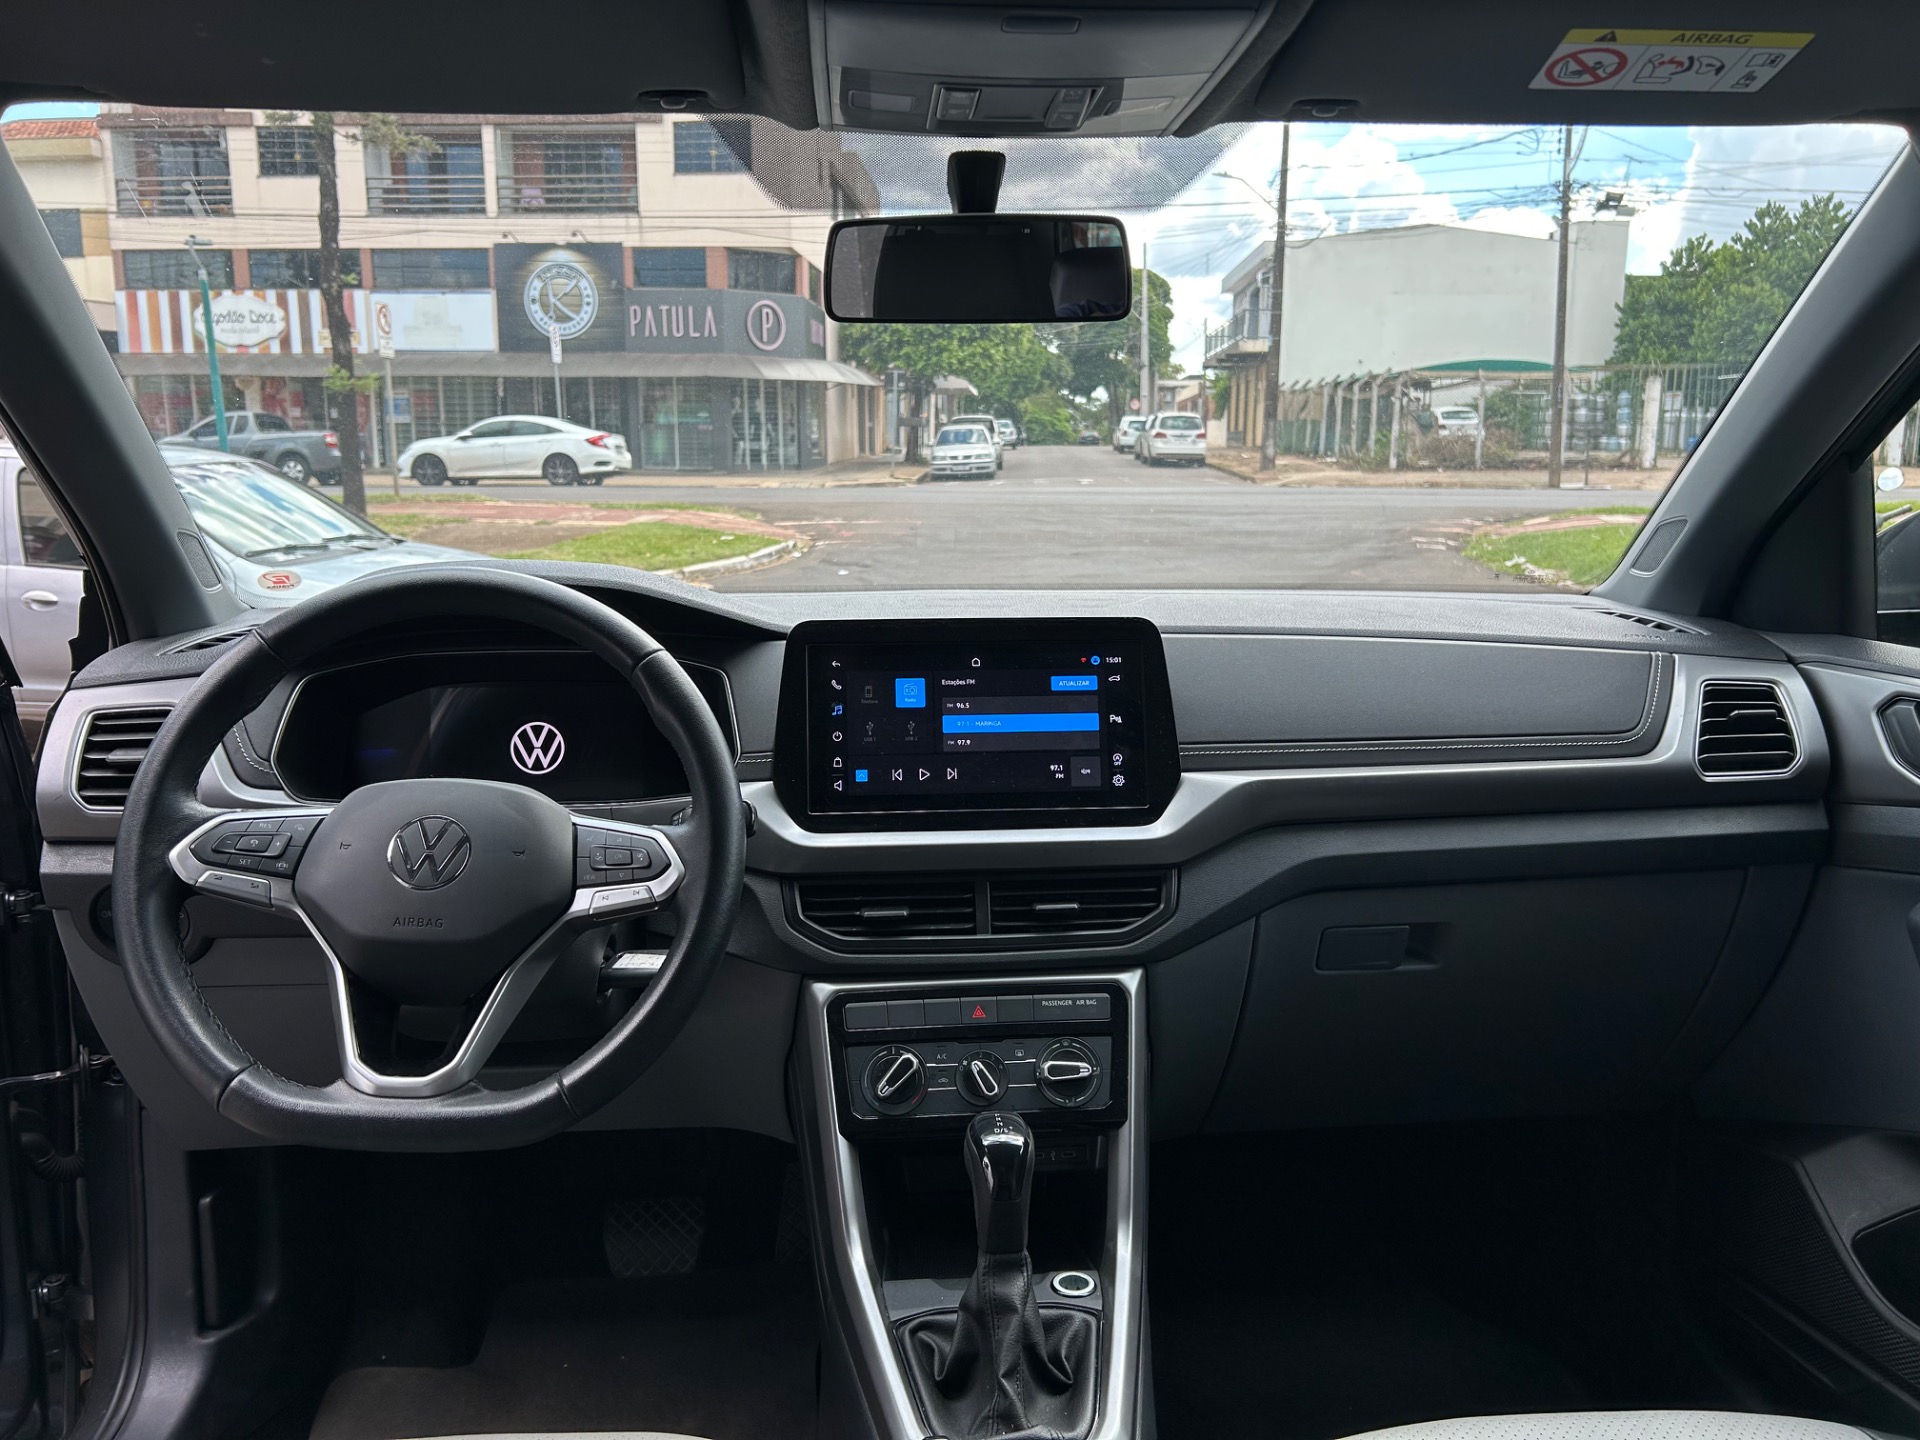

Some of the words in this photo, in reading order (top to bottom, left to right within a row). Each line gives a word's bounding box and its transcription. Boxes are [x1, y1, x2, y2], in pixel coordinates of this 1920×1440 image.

[1670, 32, 1753, 45] AIRBAG
[629, 304, 717, 338] PATULA
[761, 305, 774, 343] P
[1105, 656, 1122, 664] 15:01
[941, 678, 966, 687] Estações
[956, 701, 970, 709] 96.5
[956, 738, 971, 746] 97.9
[1049, 764, 1063, 772] 97.1
[238, 858, 253, 866] SET
[393, 916, 444, 929] AIRBAG
[1041, 999, 1073, 1007] PASSENGER
[936, 1052, 948, 1060] A/C
